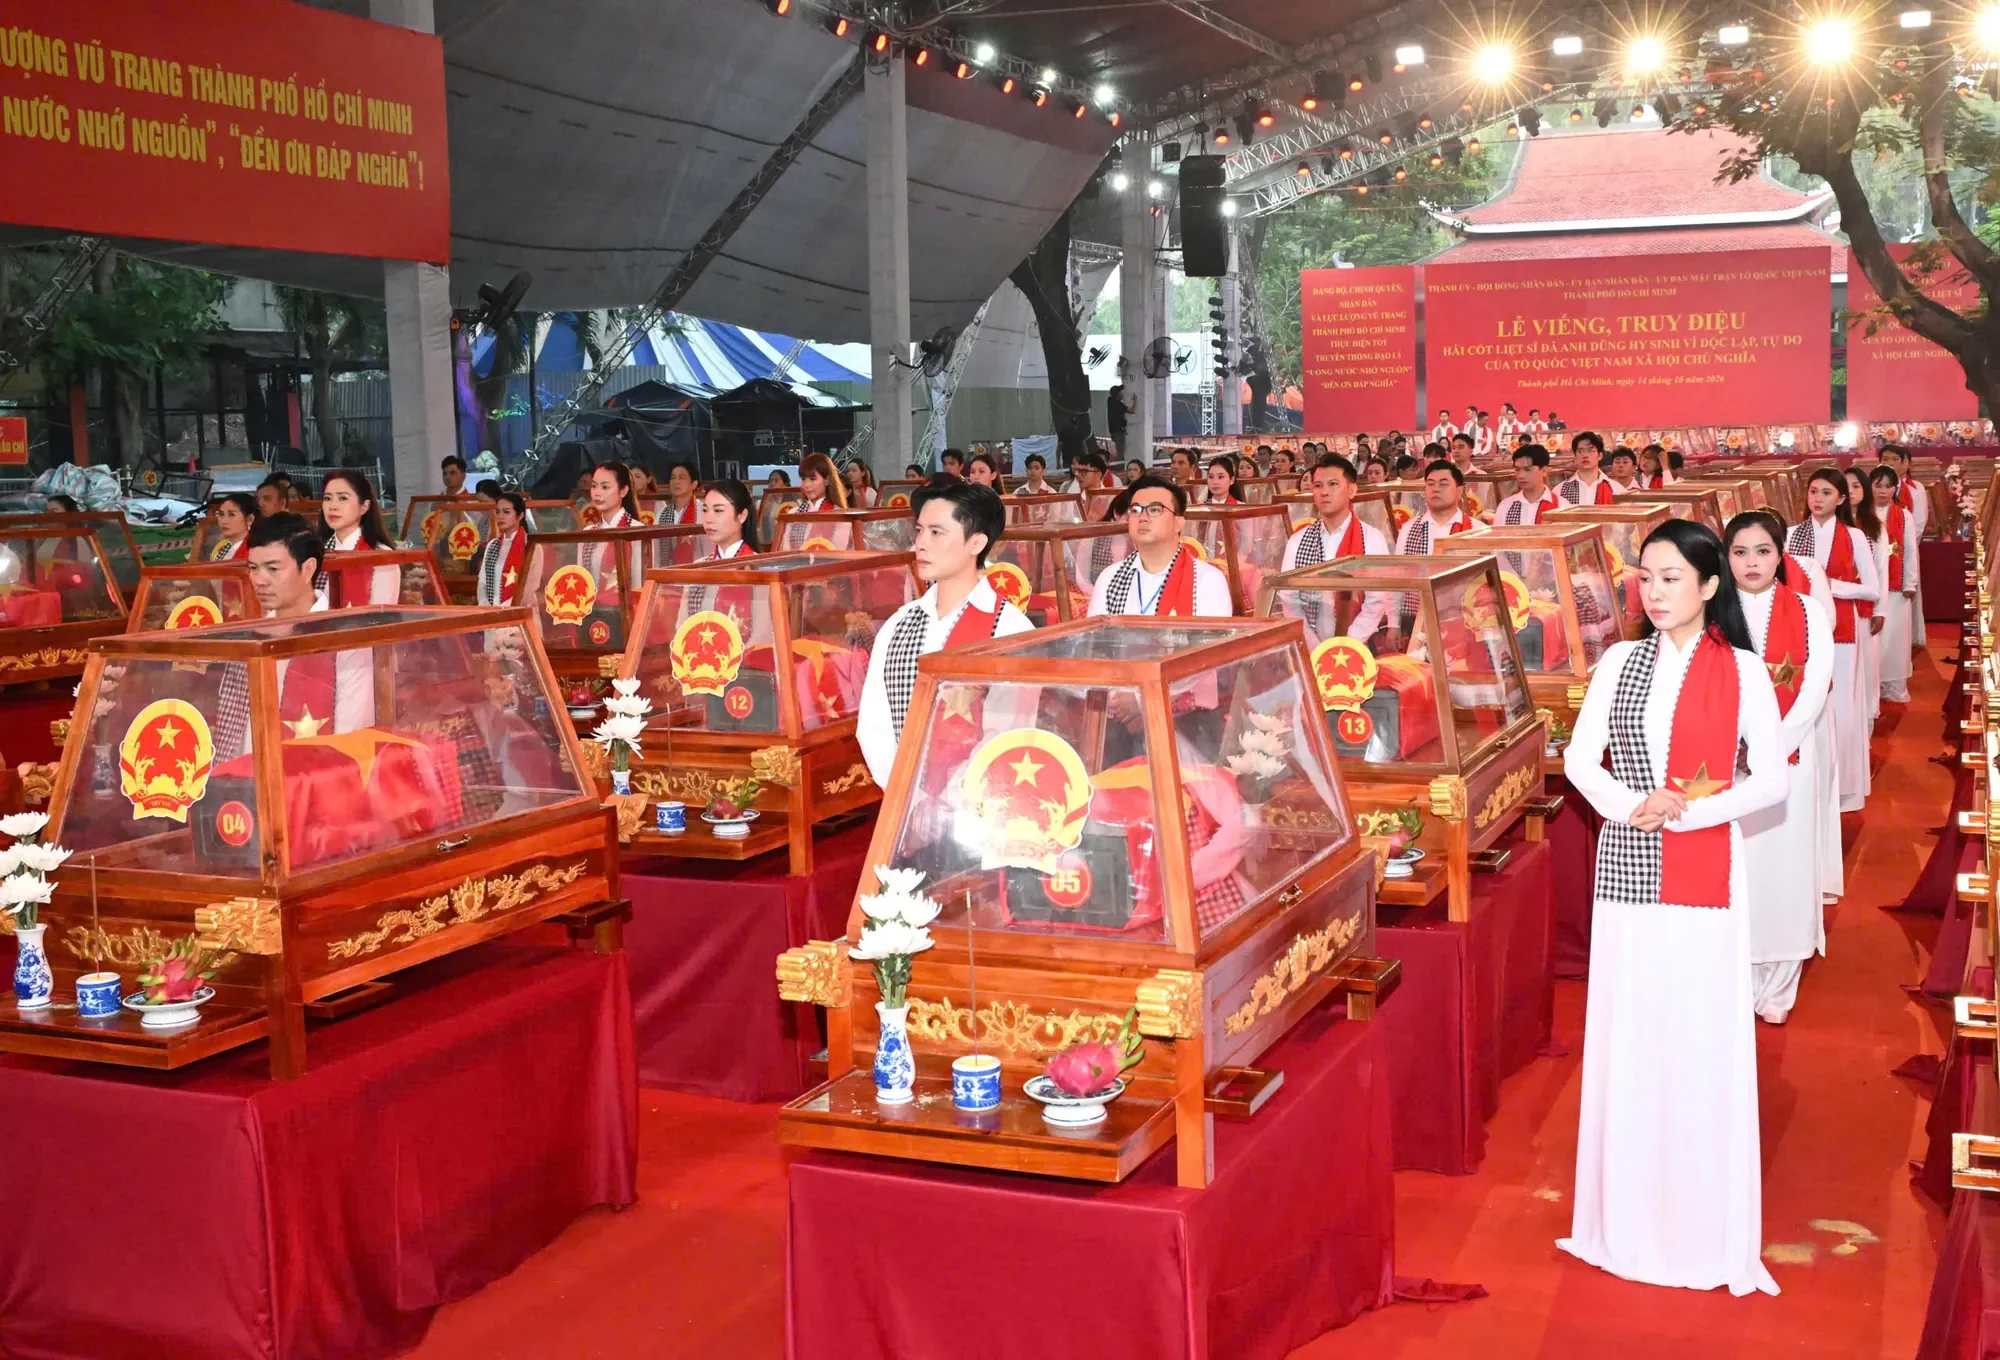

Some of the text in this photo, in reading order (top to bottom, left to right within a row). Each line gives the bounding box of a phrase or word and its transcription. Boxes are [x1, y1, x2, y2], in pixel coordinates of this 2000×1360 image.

[0, 26, 413, 136] ƯỢNG VŨ TRANG THÀNH PHỐ HỒ CHÍ MINH
[3, 95, 71, 143] NƯỚC
[77, 107, 125, 151] NHỚ
[285, 139, 311, 176] ƠN
[316, 140, 351, 181] ĐÁP
[1496, 310, 1747, 338] LỄ VIẾNG, TRUY ĐIỆU
[1443, 335, 1803, 356] HÀI CỐT LIỆT SĨ ĐÃ ANH DŨNG HY SINH VÌ ĐỘC LẬP, TỰ DO
[1485, 350, 1757, 371] CỦA TỔ QUỐC VIỆT NAM XÃ HỘI CHỦ NGHĨA
[593, 628, 606, 639] 24
[730, 695, 748, 710] 12
[1344, 718, 1366, 734] 13
[222, 814, 246, 835] 04
[1050, 869, 1081, 893] 05
